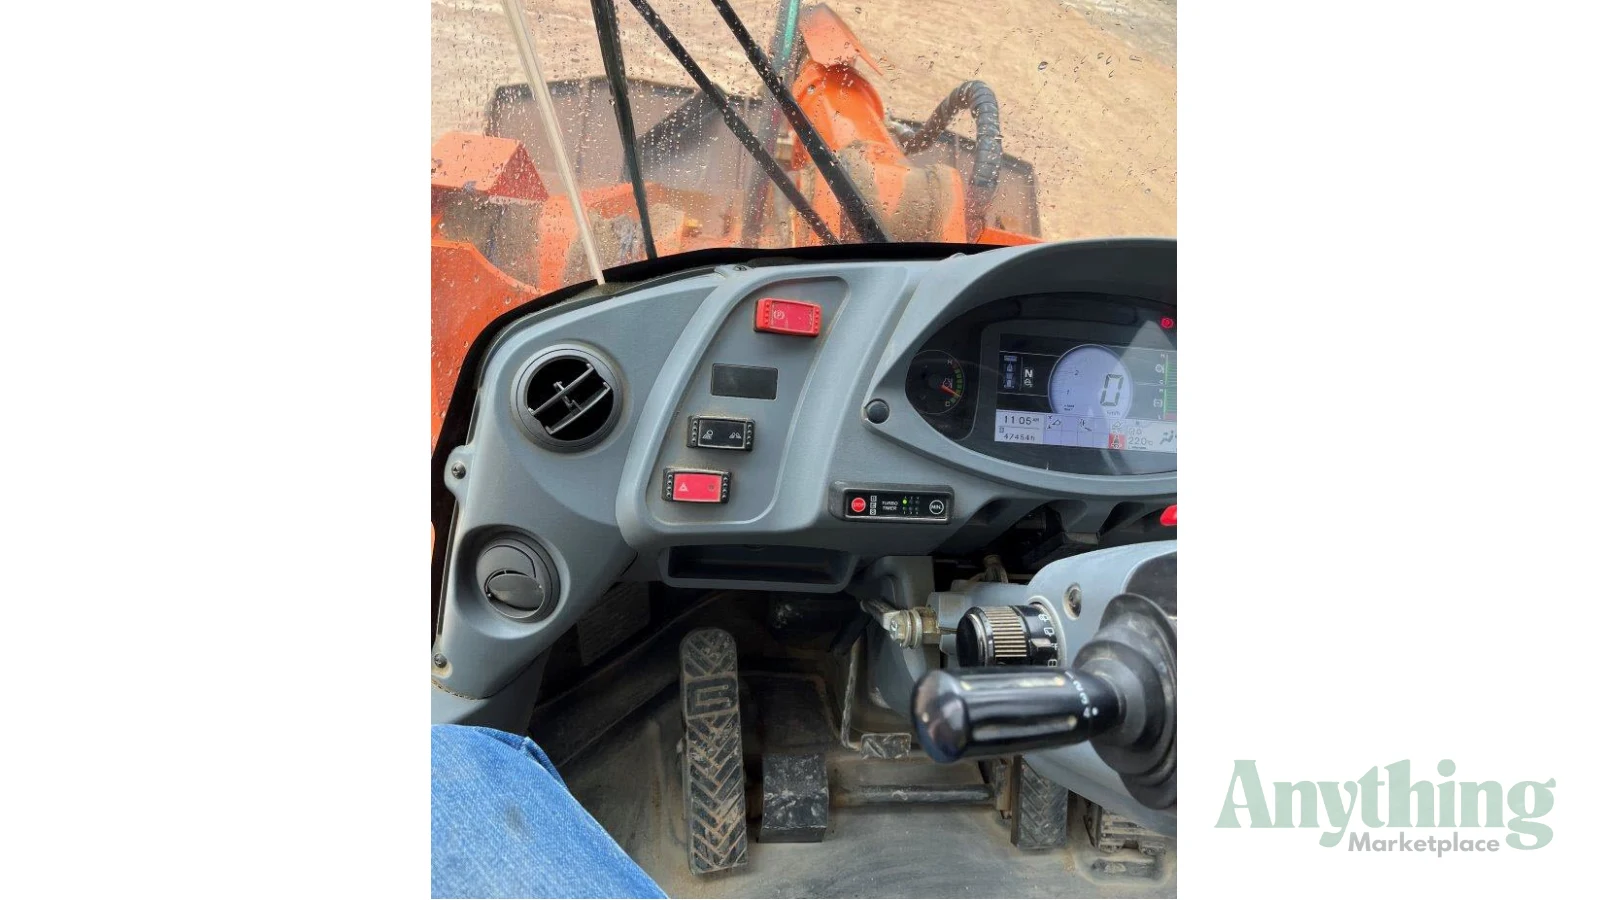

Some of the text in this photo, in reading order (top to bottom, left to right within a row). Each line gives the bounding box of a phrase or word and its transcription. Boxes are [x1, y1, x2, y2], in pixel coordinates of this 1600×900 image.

[1024, 368, 1033, 378] N
[1100, 373, 1124, 407] 0
[1073, 680, 1084, 691] 2
[1080, 692, 1089, 705] 3
[1083, 707, 1091, 718] 4
